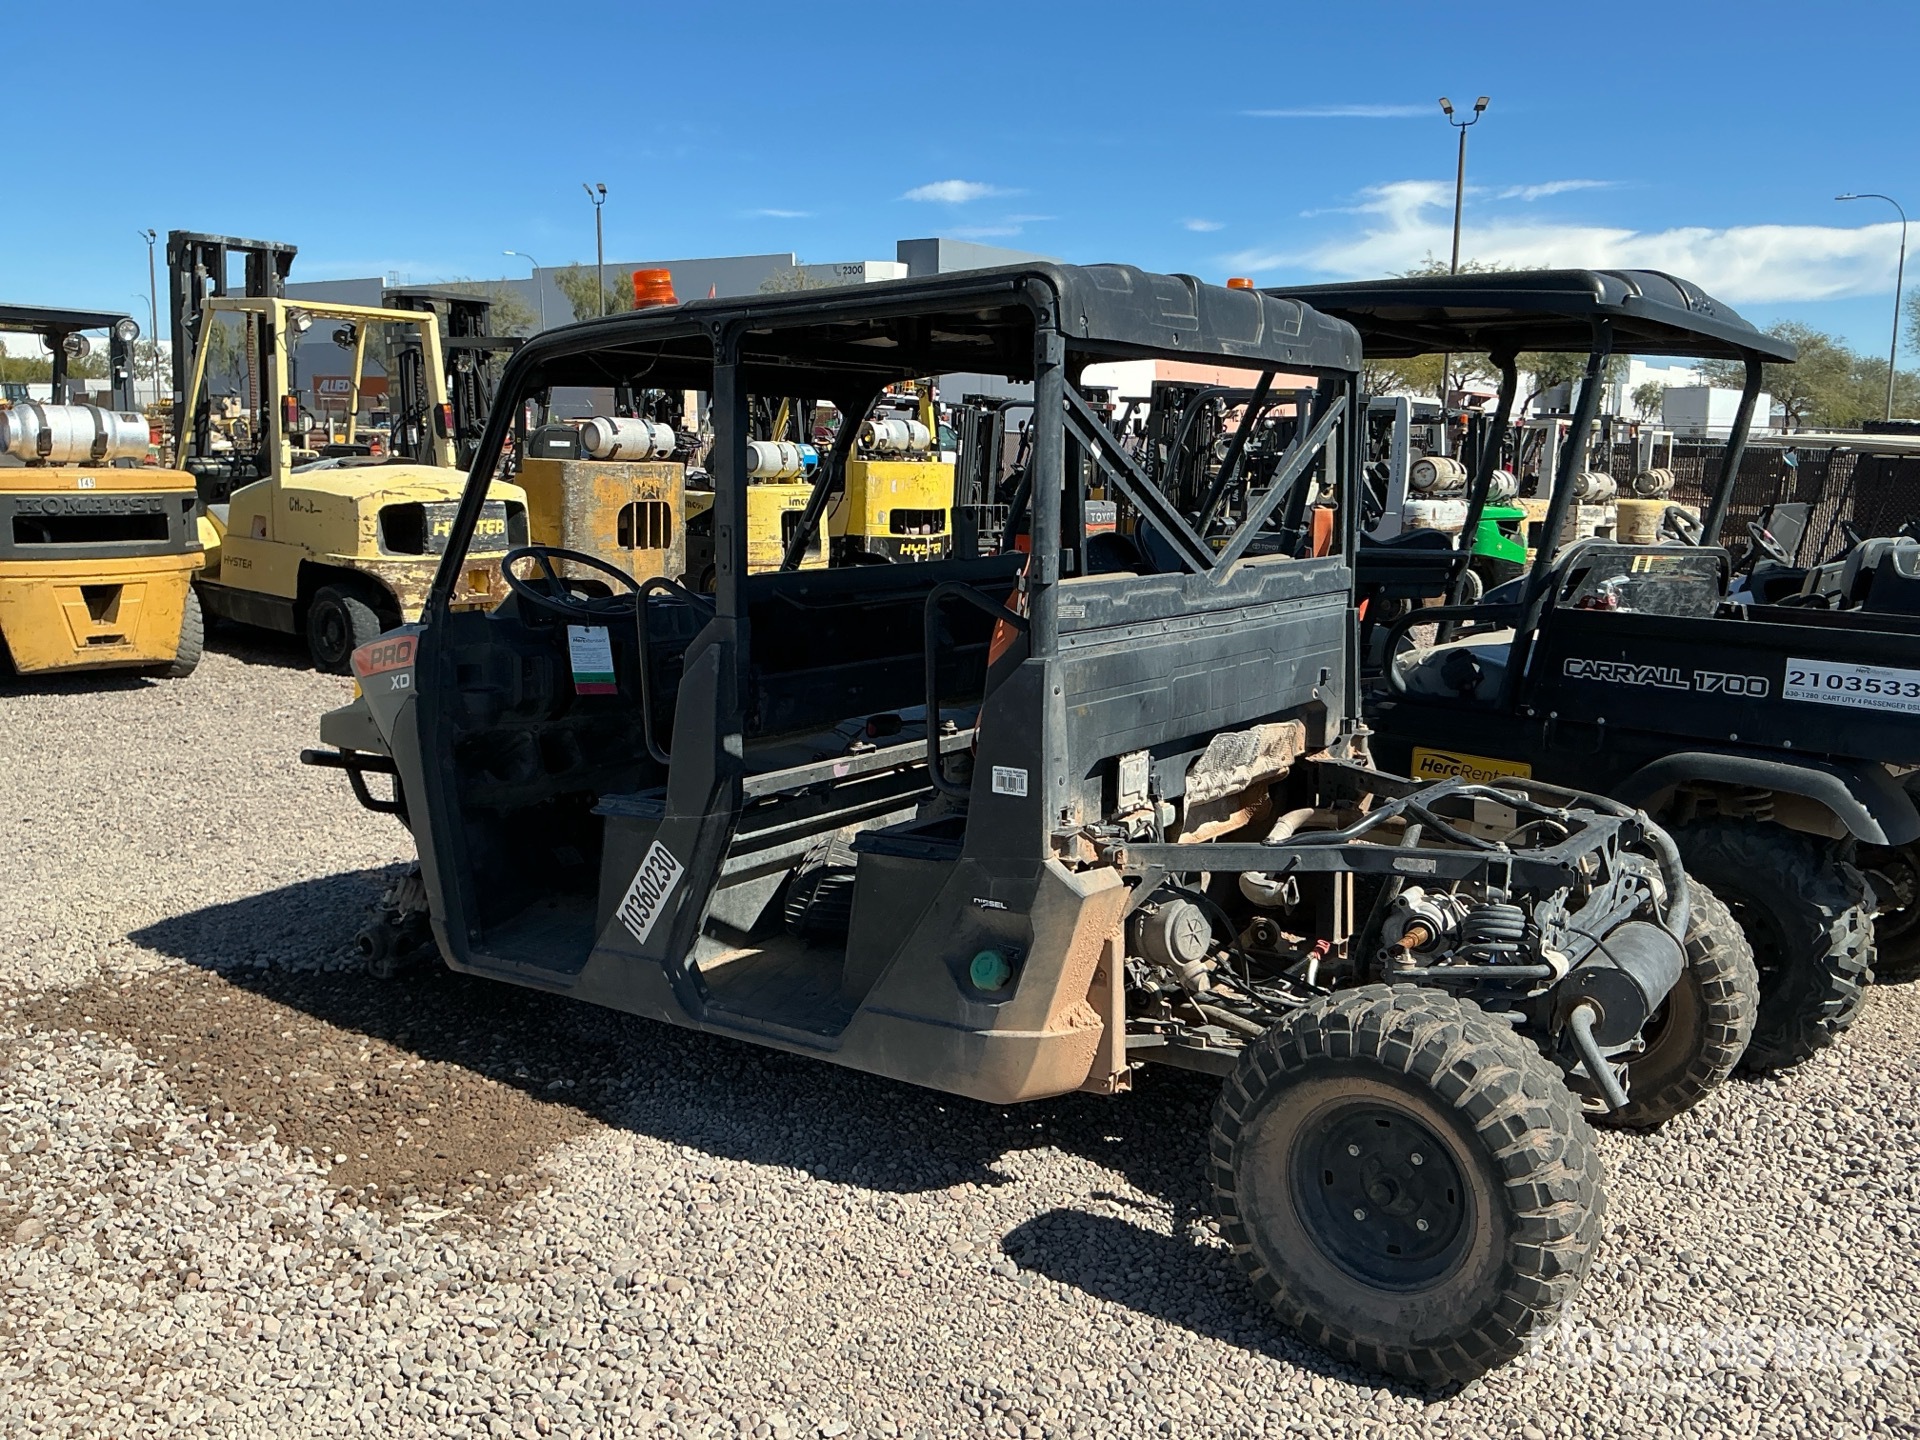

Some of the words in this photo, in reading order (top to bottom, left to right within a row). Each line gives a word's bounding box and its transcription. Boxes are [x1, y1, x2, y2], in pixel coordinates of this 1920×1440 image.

[842, 265, 863, 275] 2300
[318, 379, 351, 393] ALLIED
[1146, 438, 1156, 478] TOYOTA
[15, 496, 164, 516] KOMATSU
[432, 518, 506, 538] HTER
[223, 555, 253, 570] HYSTER
[370, 641, 412, 670] PRO
[390, 673, 410, 691] XD
[1563, 657, 1690, 690] CARRYALL
[1694, 669, 1770, 698] 1700
[1788, 670, 1920, 698] 2103533
[1784, 689, 1819, 700] 630-1280
[1821, 693, 1842, 702] CART
[1863, 698, 1907, 710] PASSENGER
[620, 846, 678, 936] 10360230
